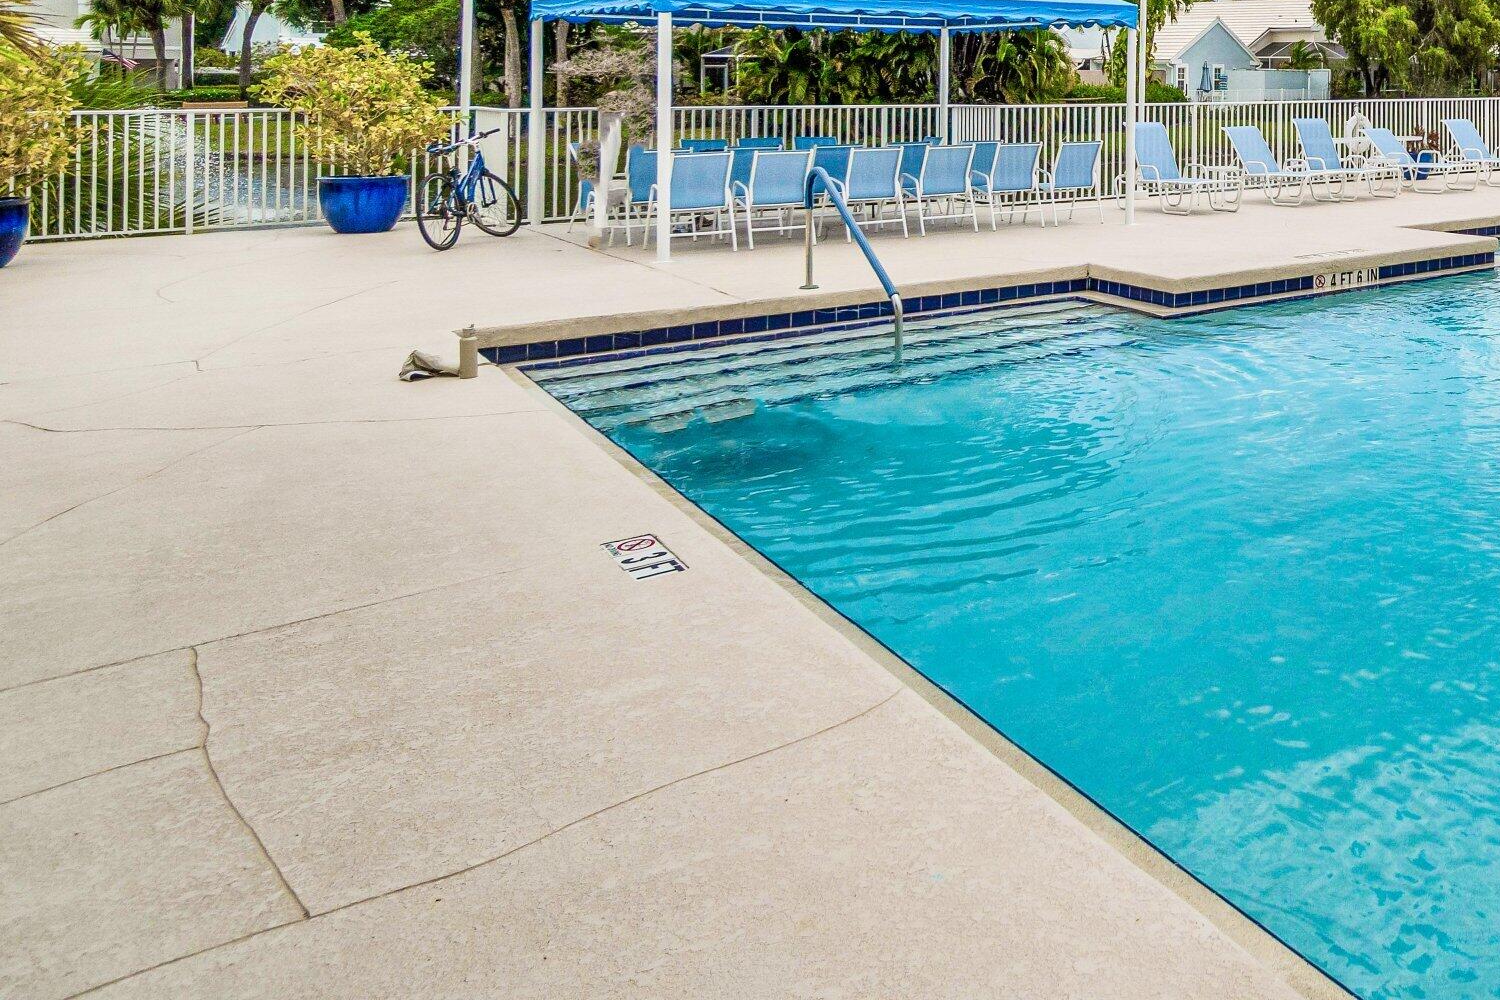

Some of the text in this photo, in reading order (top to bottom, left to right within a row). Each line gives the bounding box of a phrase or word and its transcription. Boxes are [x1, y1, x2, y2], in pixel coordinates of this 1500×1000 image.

[1330, 268, 1378, 286] 4 FT 6 IN
[620, 551, 686, 580] 3 FT
